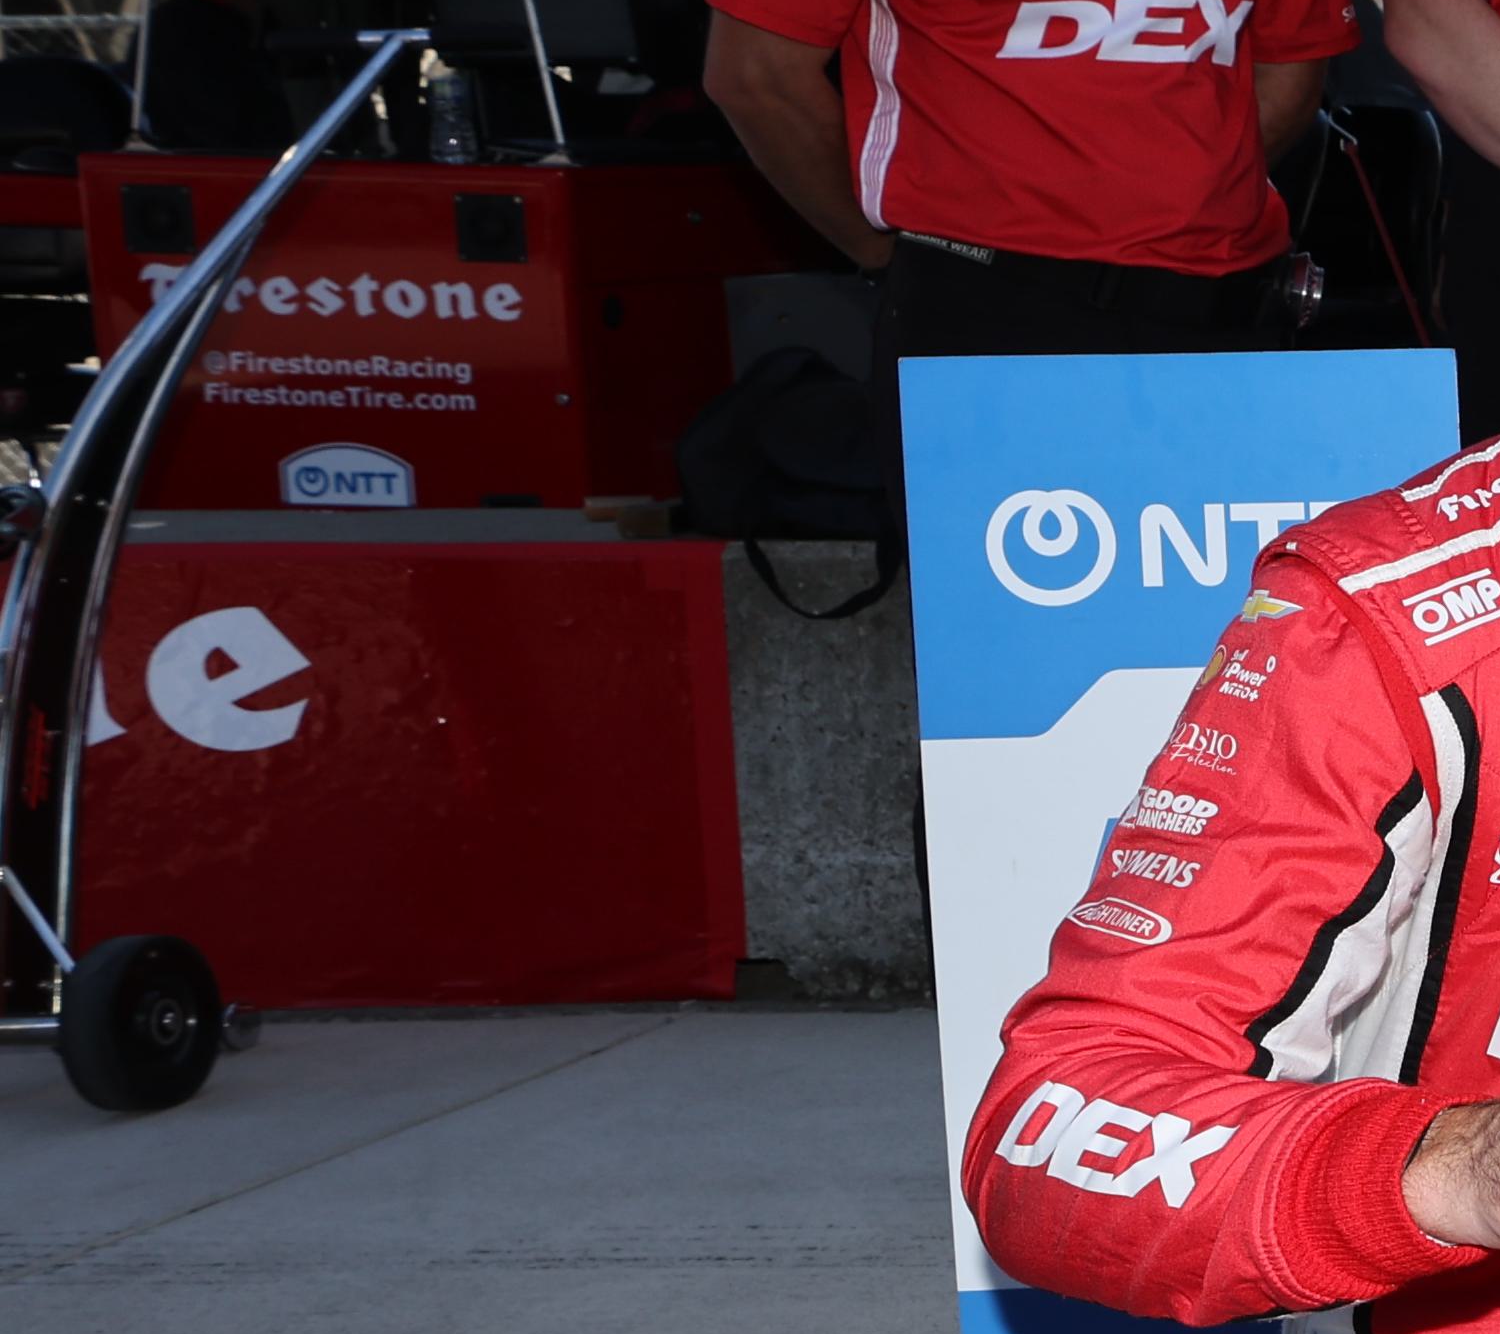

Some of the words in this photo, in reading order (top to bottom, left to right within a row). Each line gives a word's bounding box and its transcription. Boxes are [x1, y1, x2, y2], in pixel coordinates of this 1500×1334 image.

[205, 350, 472, 383] @FirestoneRacing
[203, 382, 477, 411] FirestoneTire.com
[334, 471, 398, 496] NTT
[1140, 501, 1339, 588] NT
[1142, 787, 1219, 820] GOOD
[1135, 808, 1208, 837] RANCHERS
[995, 1080, 1241, 1209] DEX
